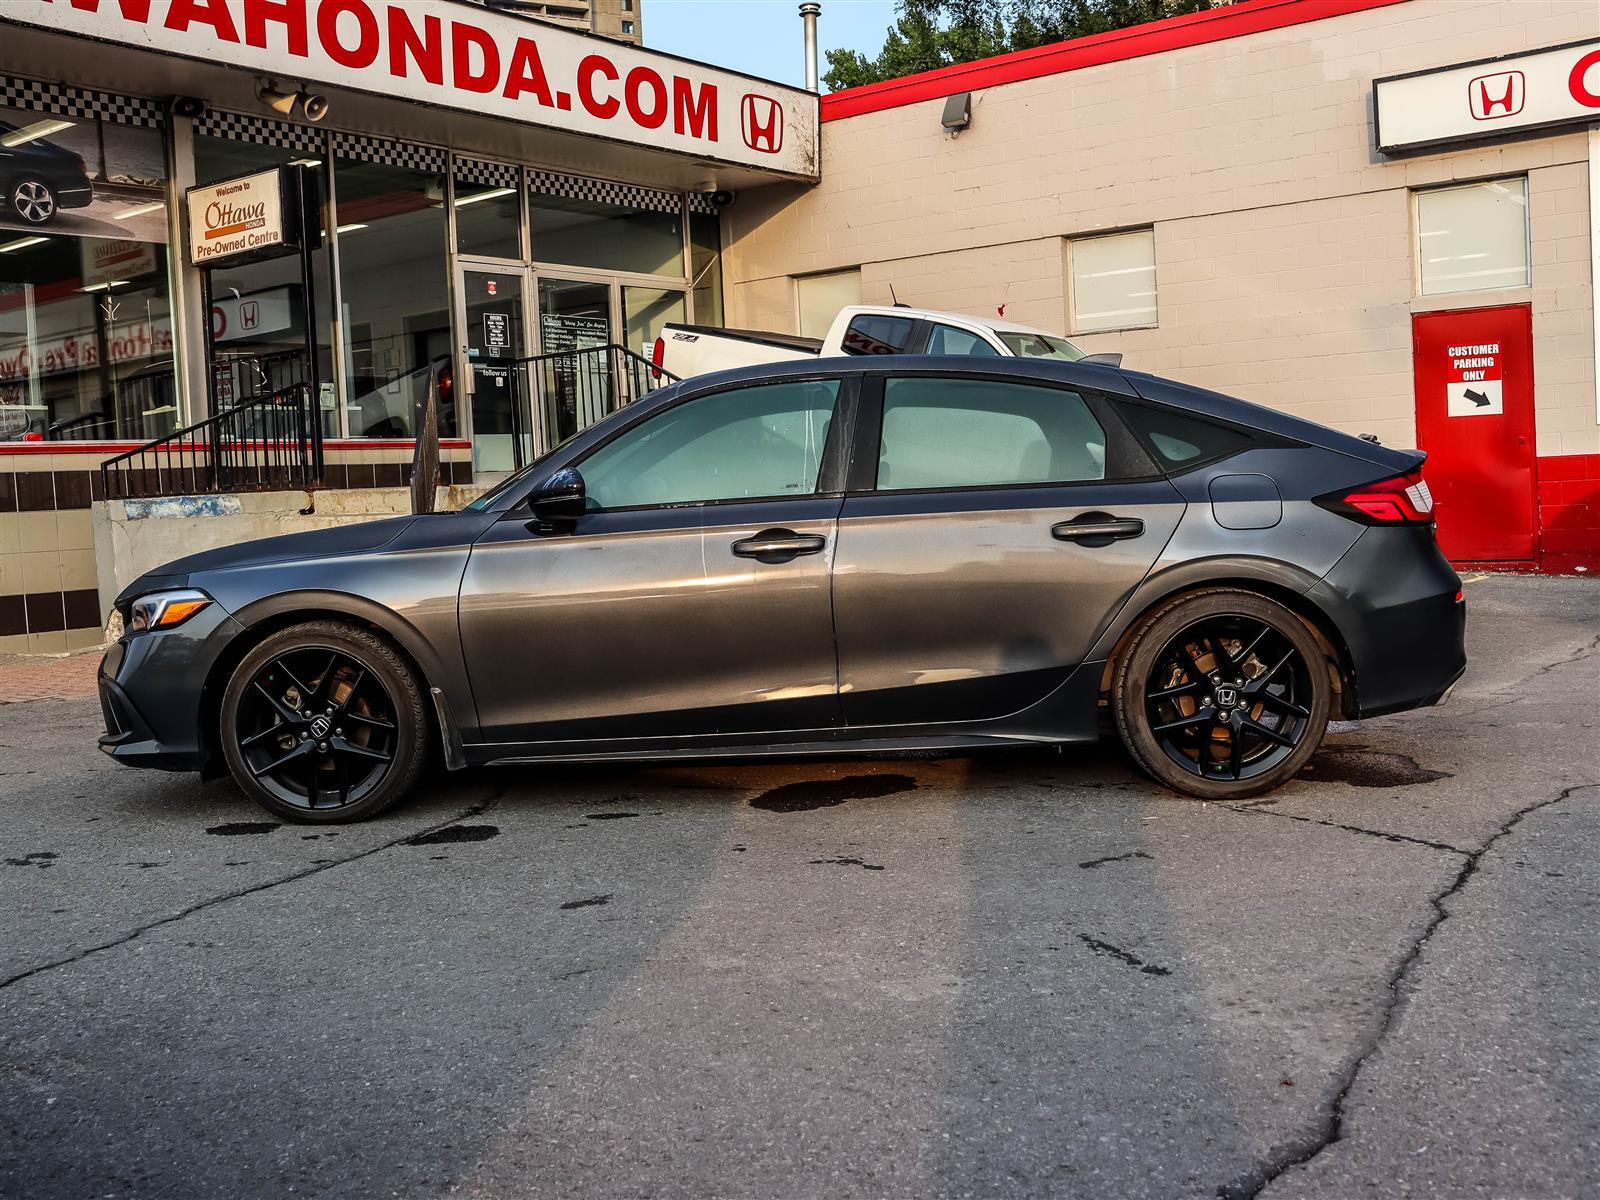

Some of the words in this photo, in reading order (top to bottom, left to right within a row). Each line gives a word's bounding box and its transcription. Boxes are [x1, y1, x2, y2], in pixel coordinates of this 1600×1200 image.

[41, 0, 719, 142] AHONDA.COM
[216, 186, 243, 197] Welcome
[243, 182, 250, 190] to
[205, 201, 265, 229] Ottawa
[245, 219, 265, 229] HONDA
[197, 236, 246, 258] Pre-Owned
[248, 231, 279, 246] Centre
[1448, 344, 1499, 357] CUSTOMER
[1453, 357, 1494, 369] PARKING
[1463, 370, 1485, 381] ONLY
